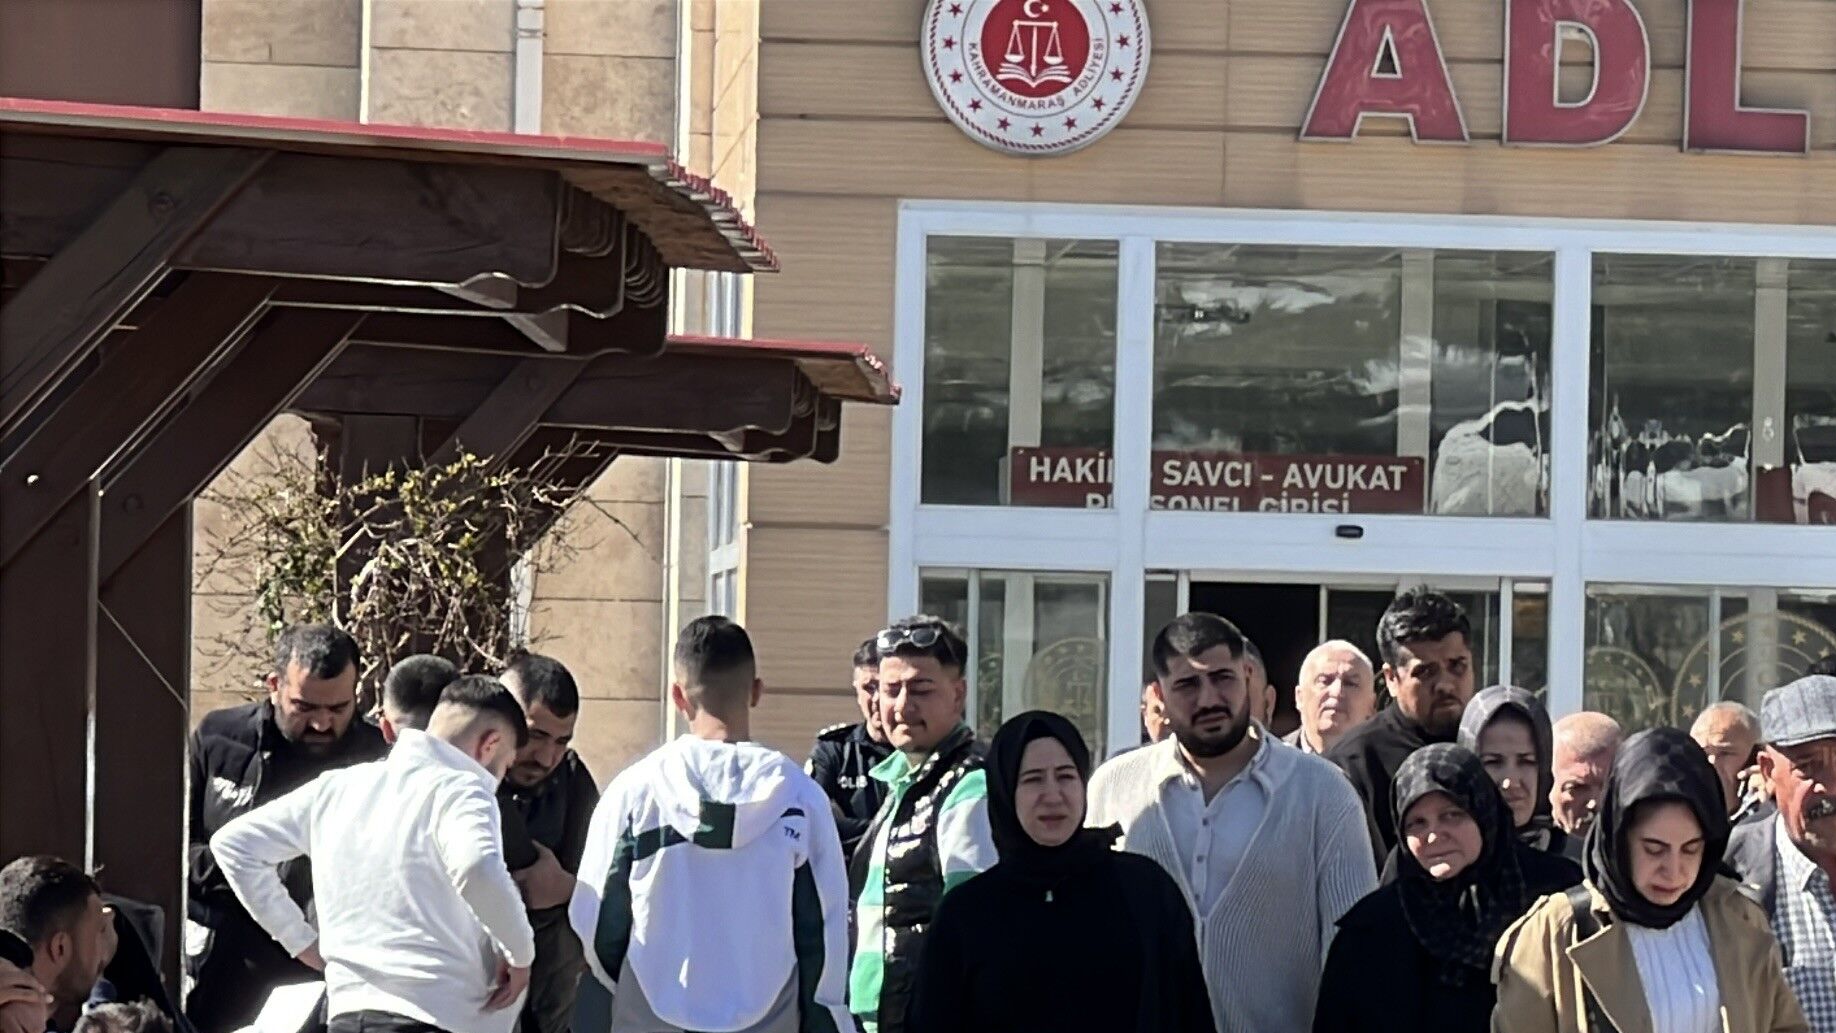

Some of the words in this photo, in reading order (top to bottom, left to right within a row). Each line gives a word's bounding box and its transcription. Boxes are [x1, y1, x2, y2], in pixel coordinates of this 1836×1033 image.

[1029, 451, 1114, 484] HAKİ
[1162, 459, 1252, 488] SAVCI
[1282, 463, 1408, 492] AVUKAT
